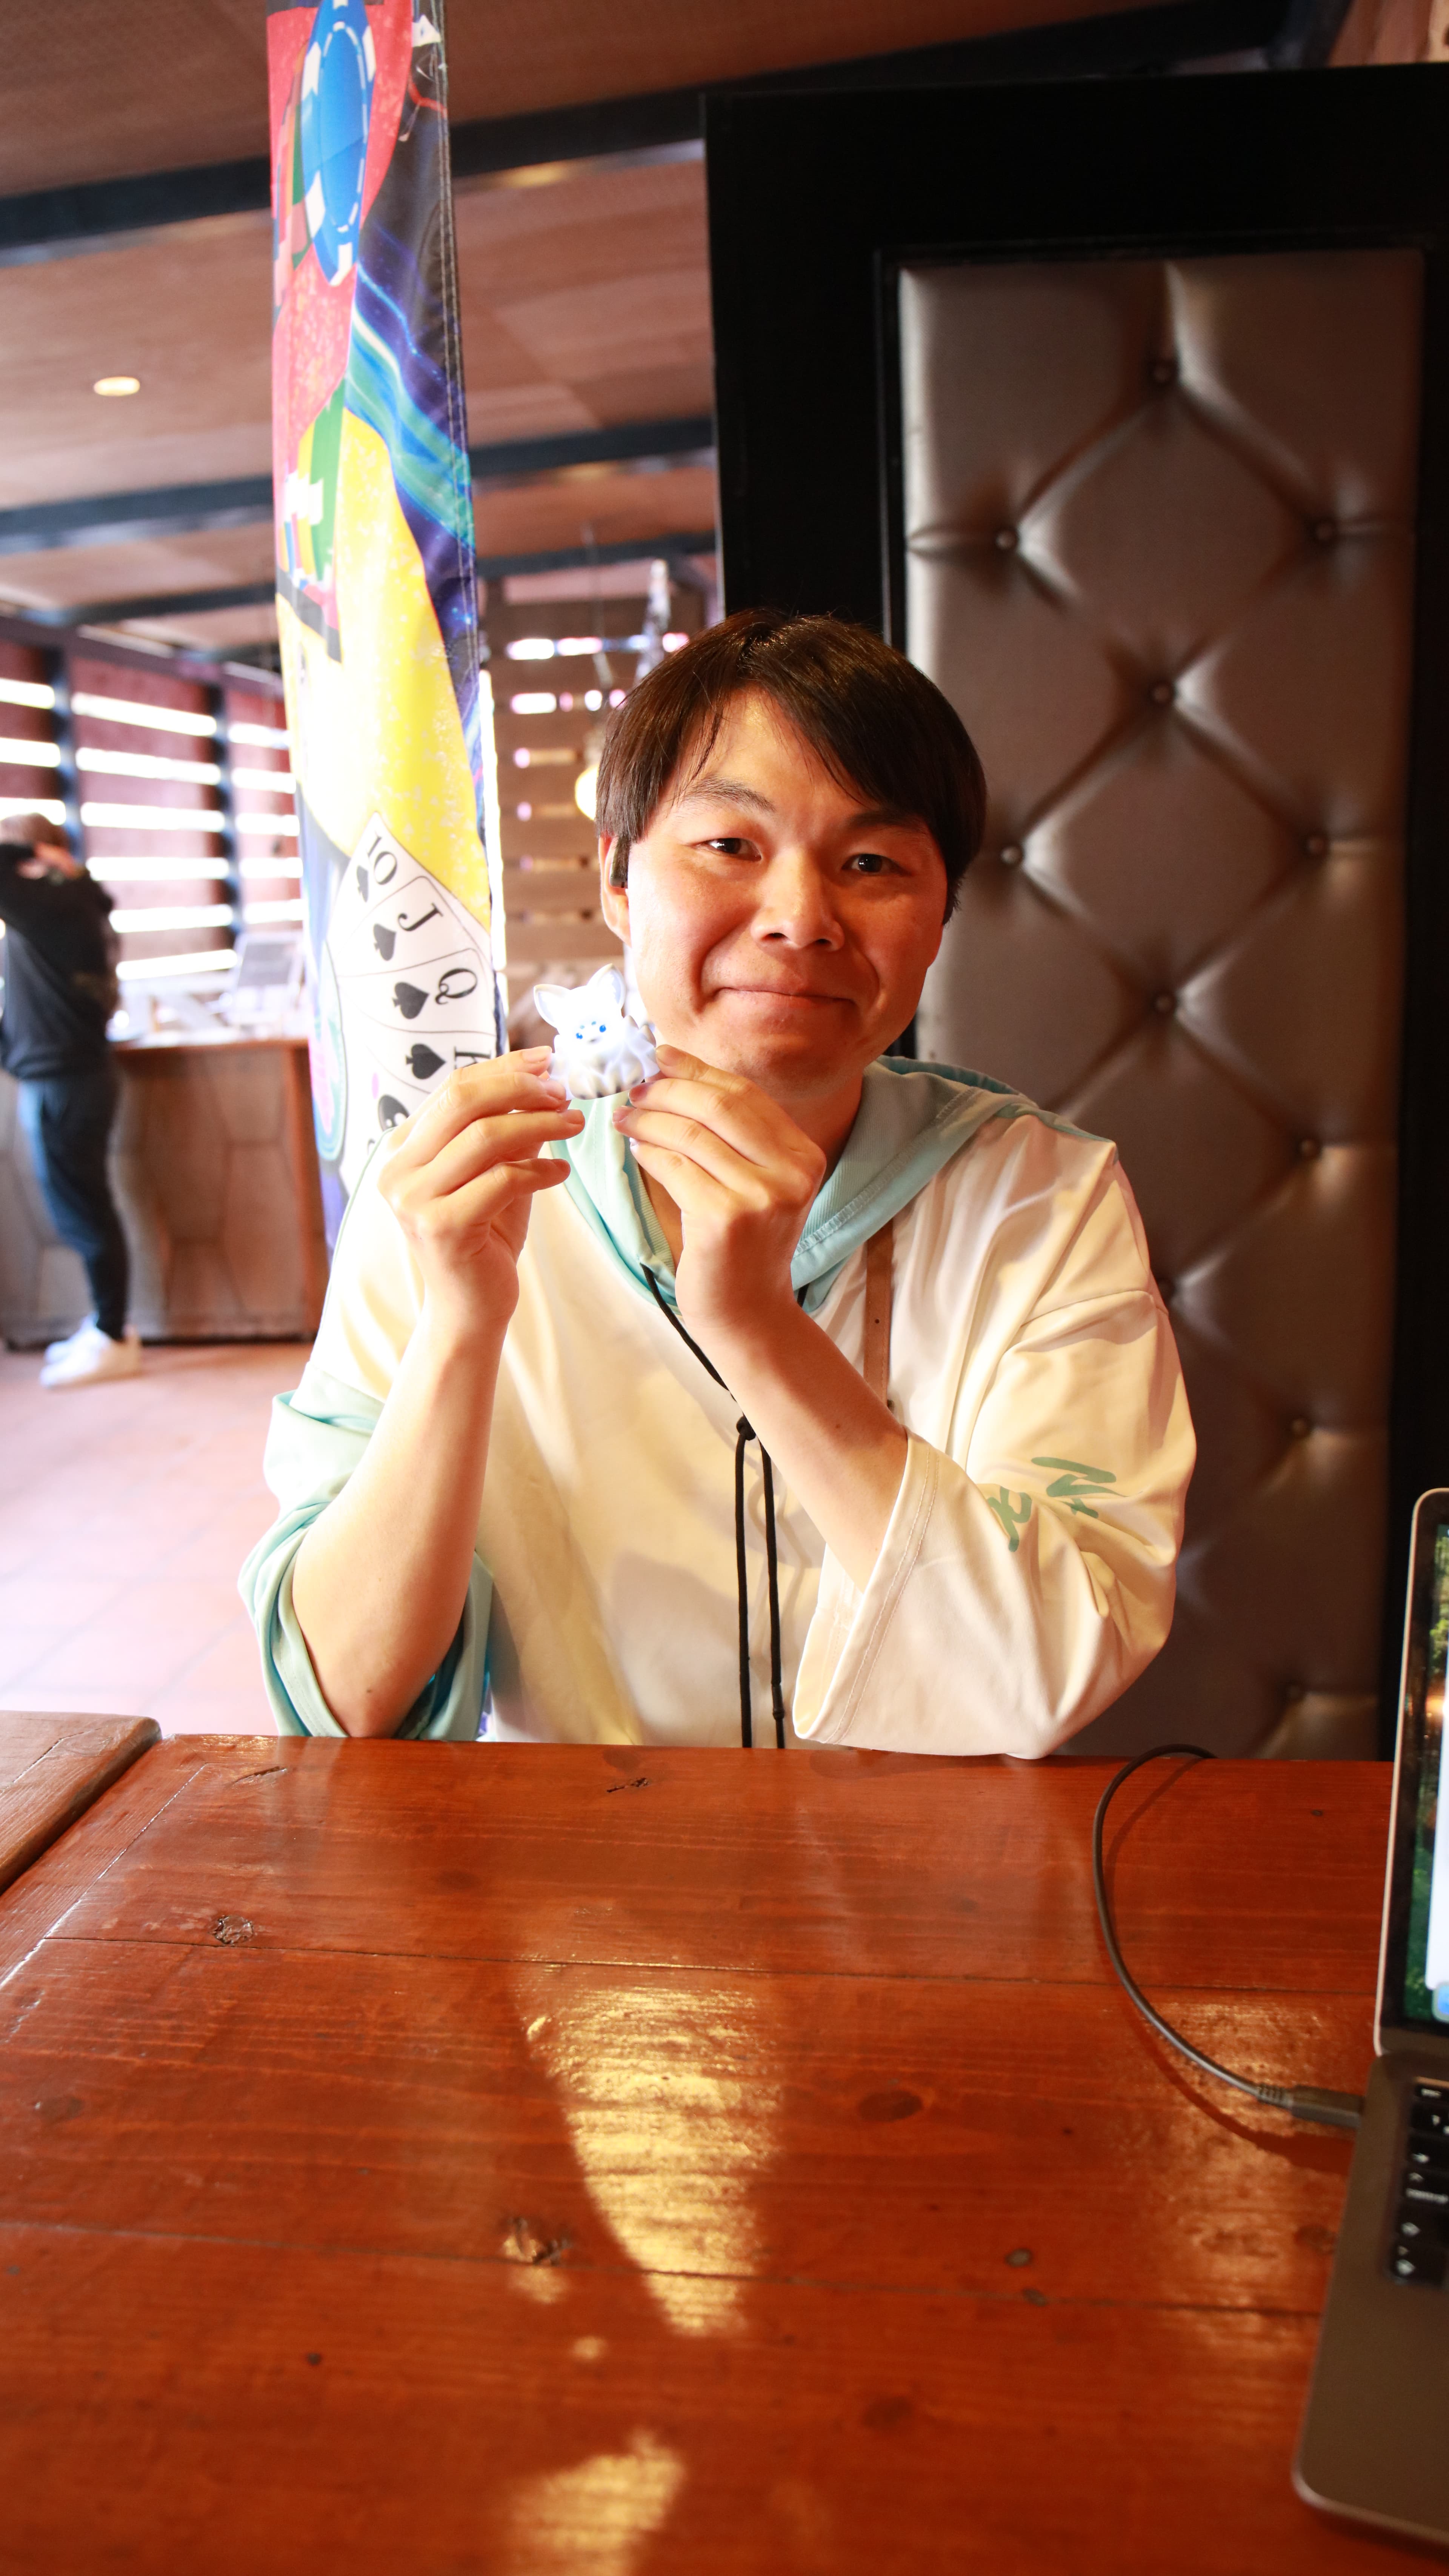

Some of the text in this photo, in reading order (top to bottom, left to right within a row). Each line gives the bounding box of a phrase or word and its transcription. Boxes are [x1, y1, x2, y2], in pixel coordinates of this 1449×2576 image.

[366, 830, 398, 885] 10
[396, 903, 443, 932] J
[435, 968, 477, 1005] Q
